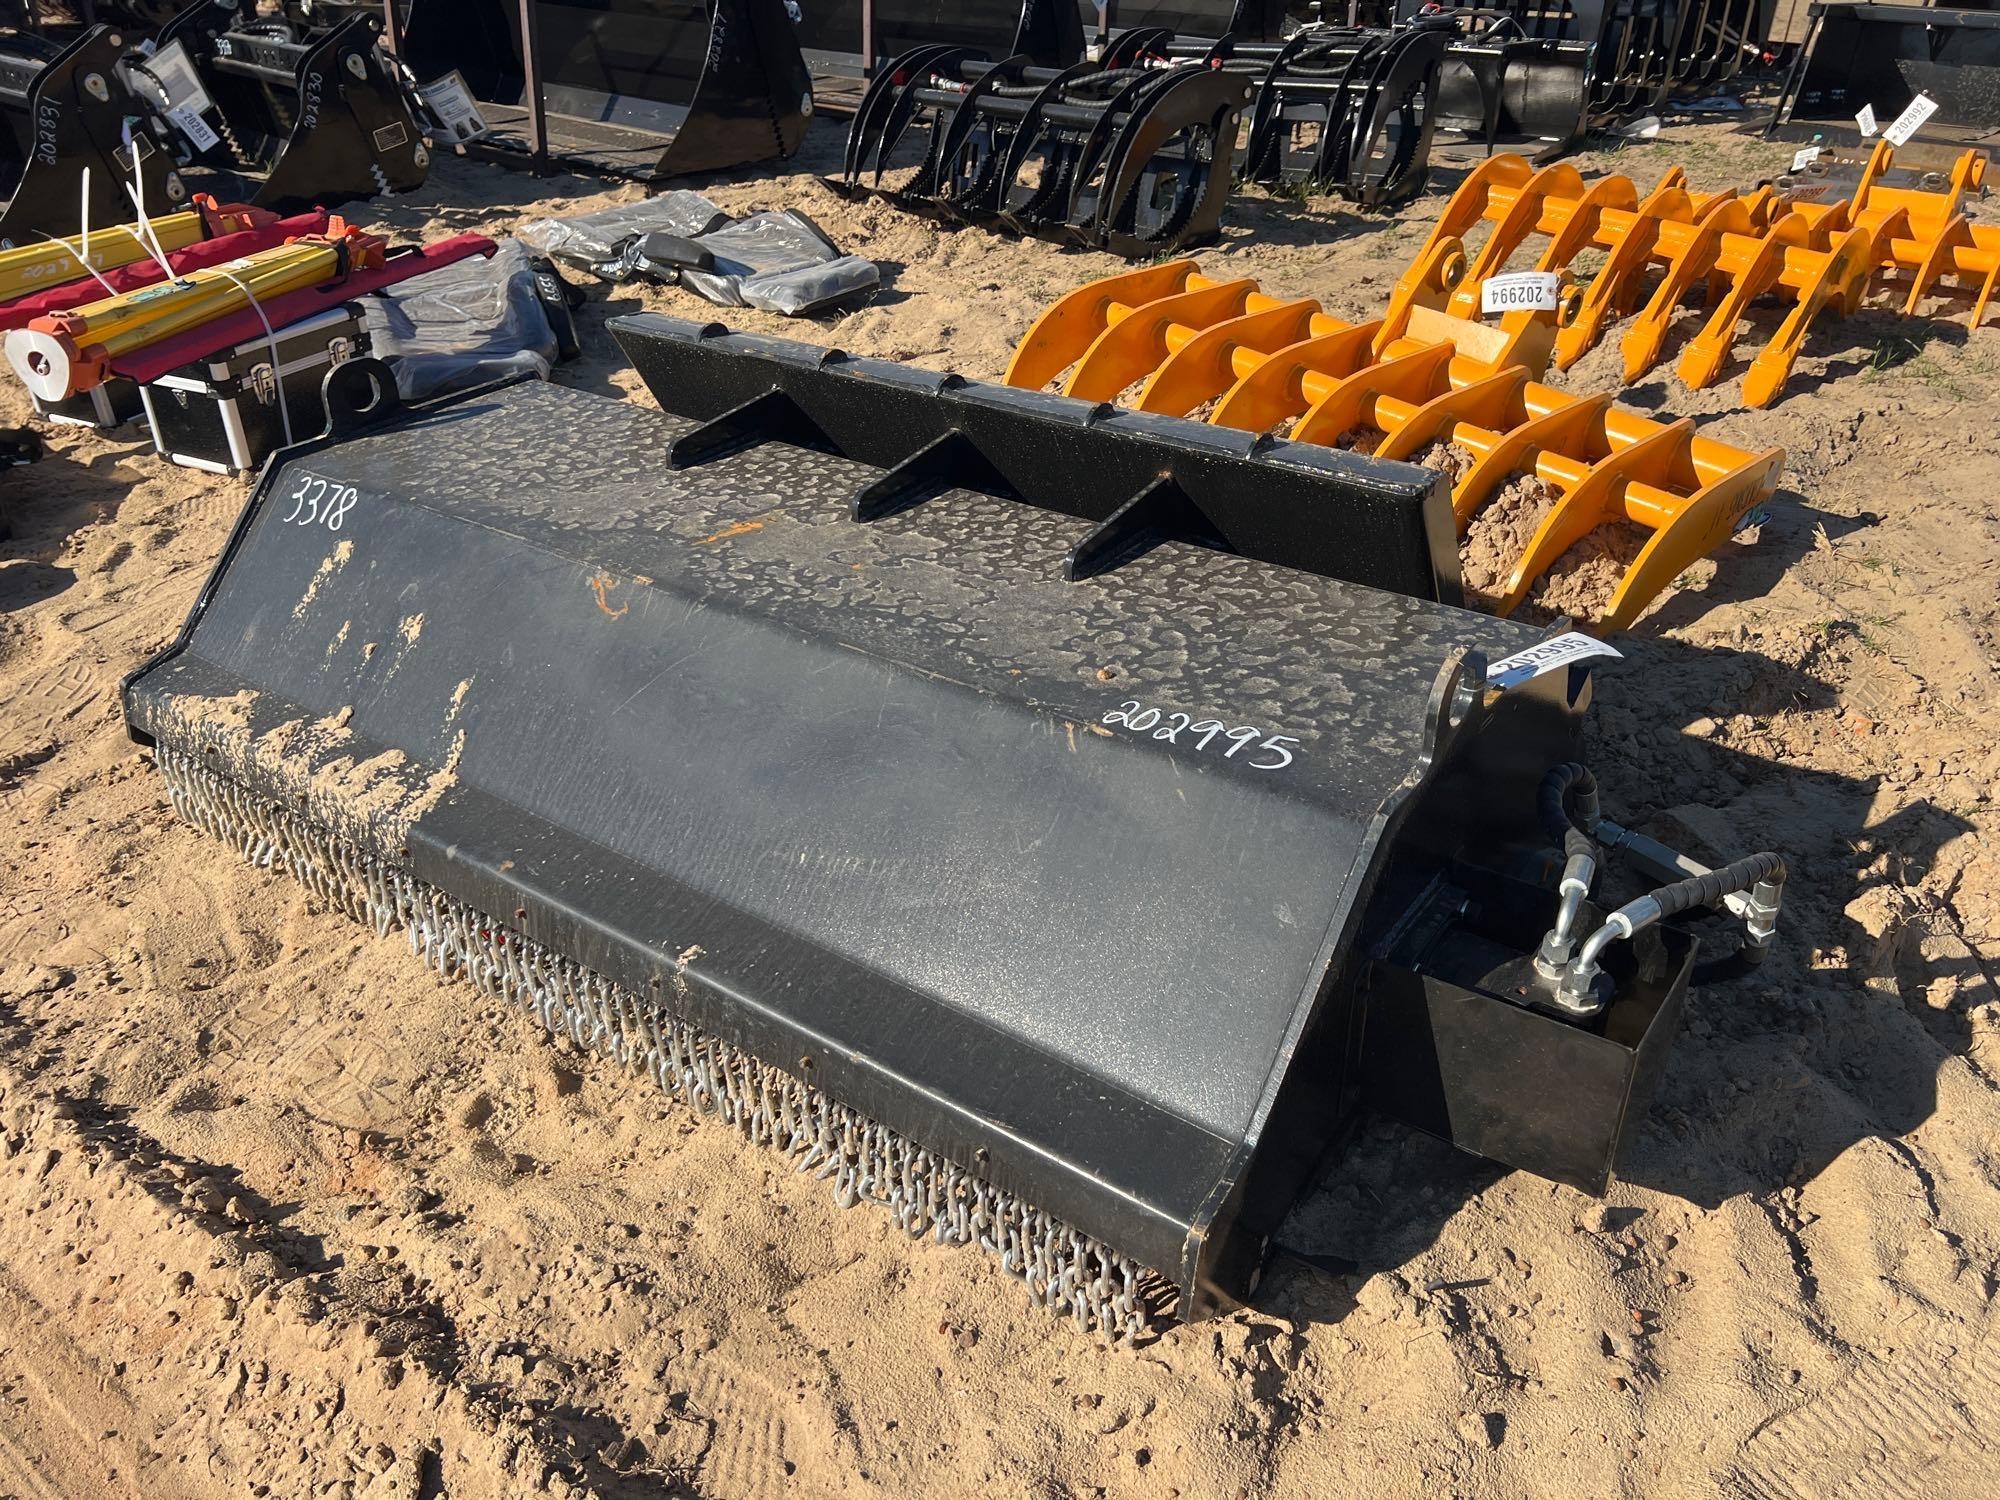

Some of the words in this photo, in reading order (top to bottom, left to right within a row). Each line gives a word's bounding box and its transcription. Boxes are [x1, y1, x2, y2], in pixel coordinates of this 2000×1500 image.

[304, 72, 323, 129] 202830
[1895, 102, 1927, 134] 202992
[37, 95, 62, 165] 202831
[184, 112, 212, 142] 202831
[1491, 286, 1543, 305] 202994
[283, 476, 358, 531] 3378
[1495, 637, 1589, 671] 202995
[1102, 701, 1300, 770] 202995
